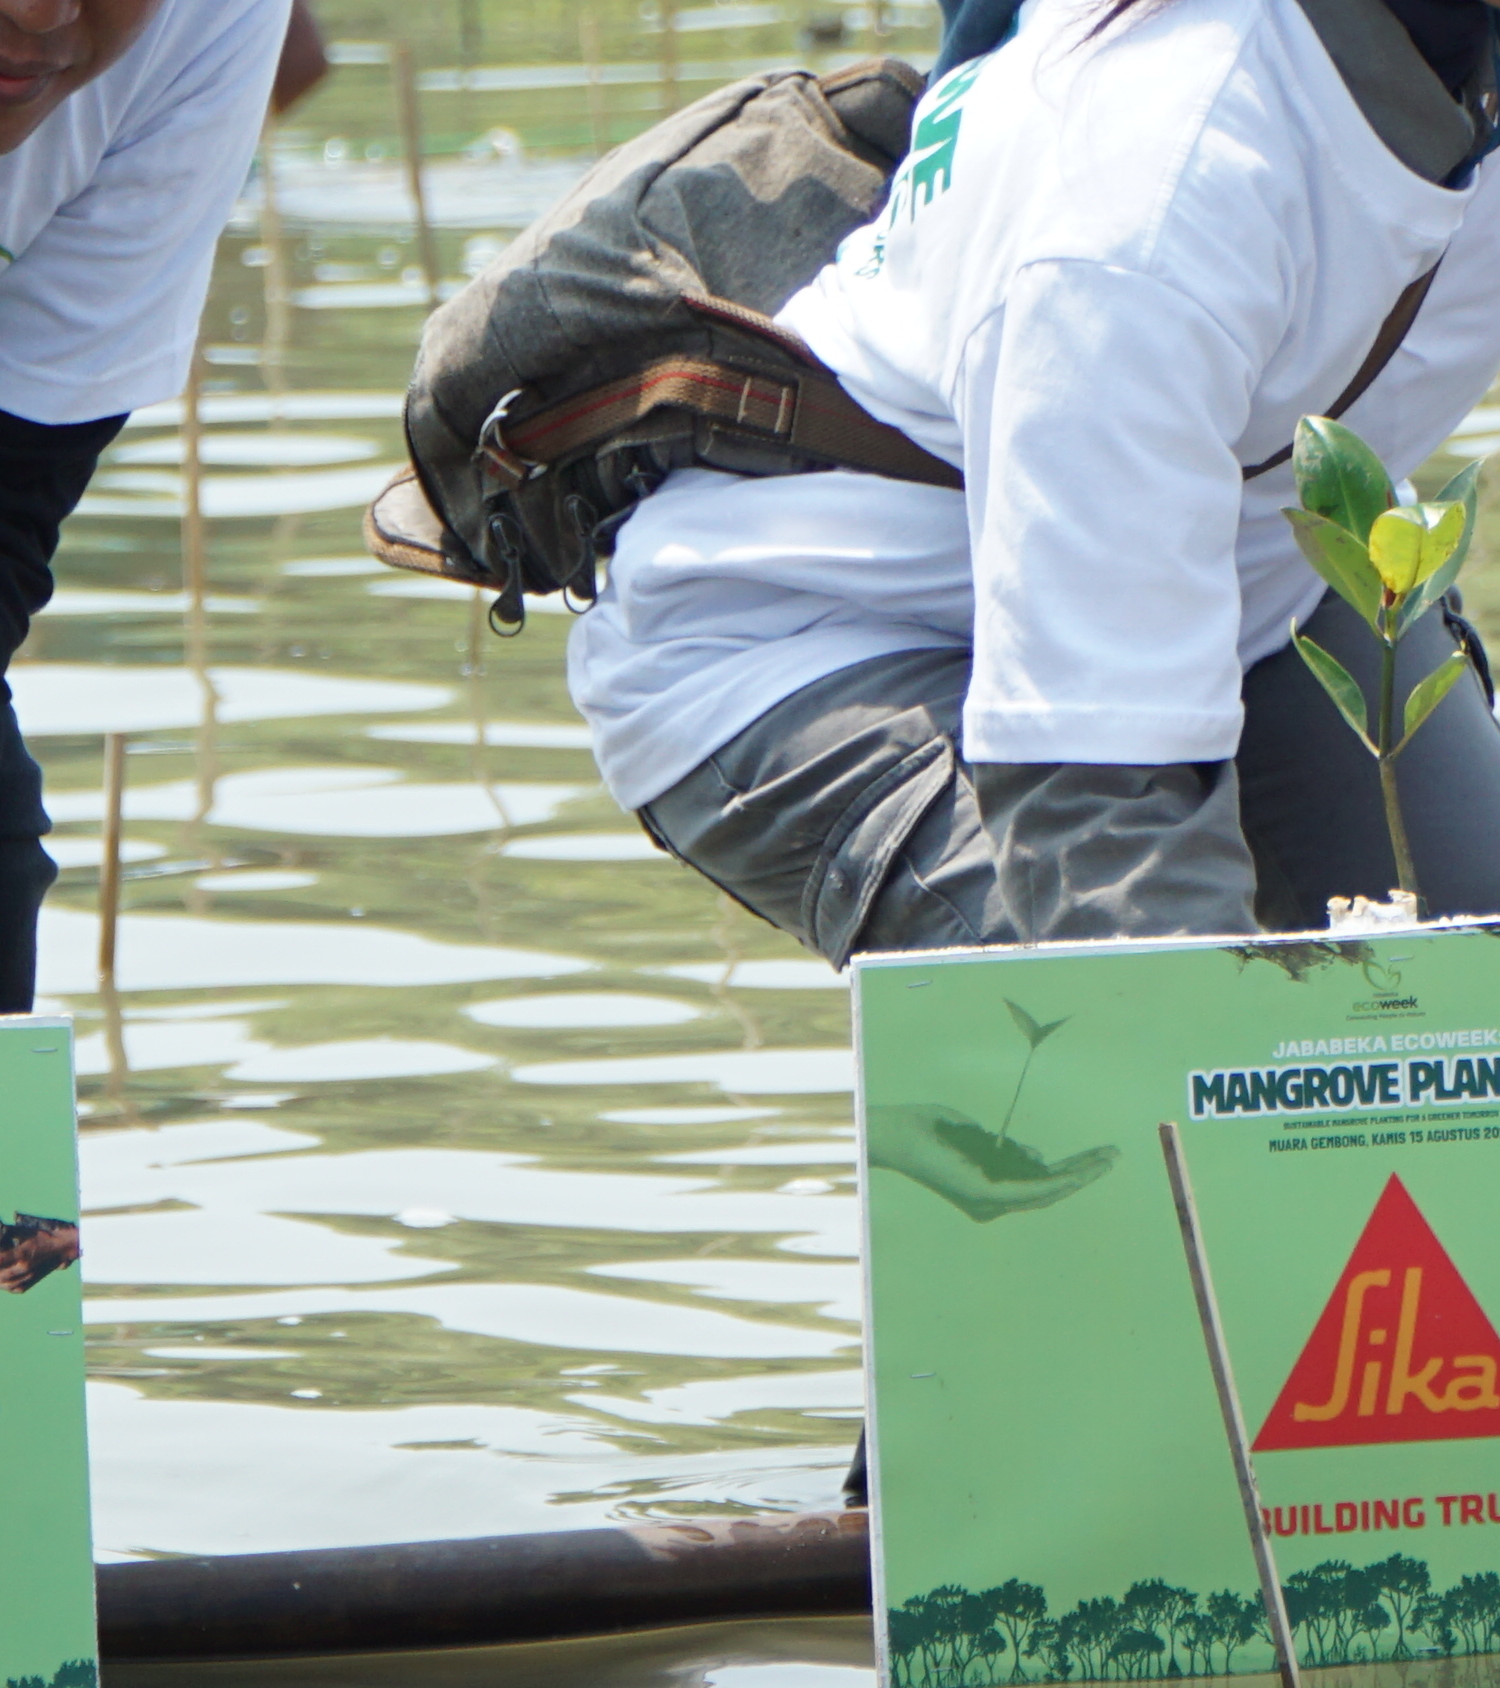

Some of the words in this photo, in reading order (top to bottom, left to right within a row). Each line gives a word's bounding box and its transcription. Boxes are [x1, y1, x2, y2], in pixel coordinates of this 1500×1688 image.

[1352, 995, 1419, 1012] ecoweek
[1272, 1036, 1386, 1059] JABABEKA
[1191, 1062, 1401, 1116] MANGROVE
[1269, 1137, 1308, 1152] MUARA
[1311, 1133, 1369, 1150] GEMBONG,
[1372, 1131, 1406, 1146] KAMIS
[1410, 1130, 1424, 1144] 15
[1427, 1127, 1480, 1143] AGUSTUS
[1294, 1267, 1500, 1422] Sika
